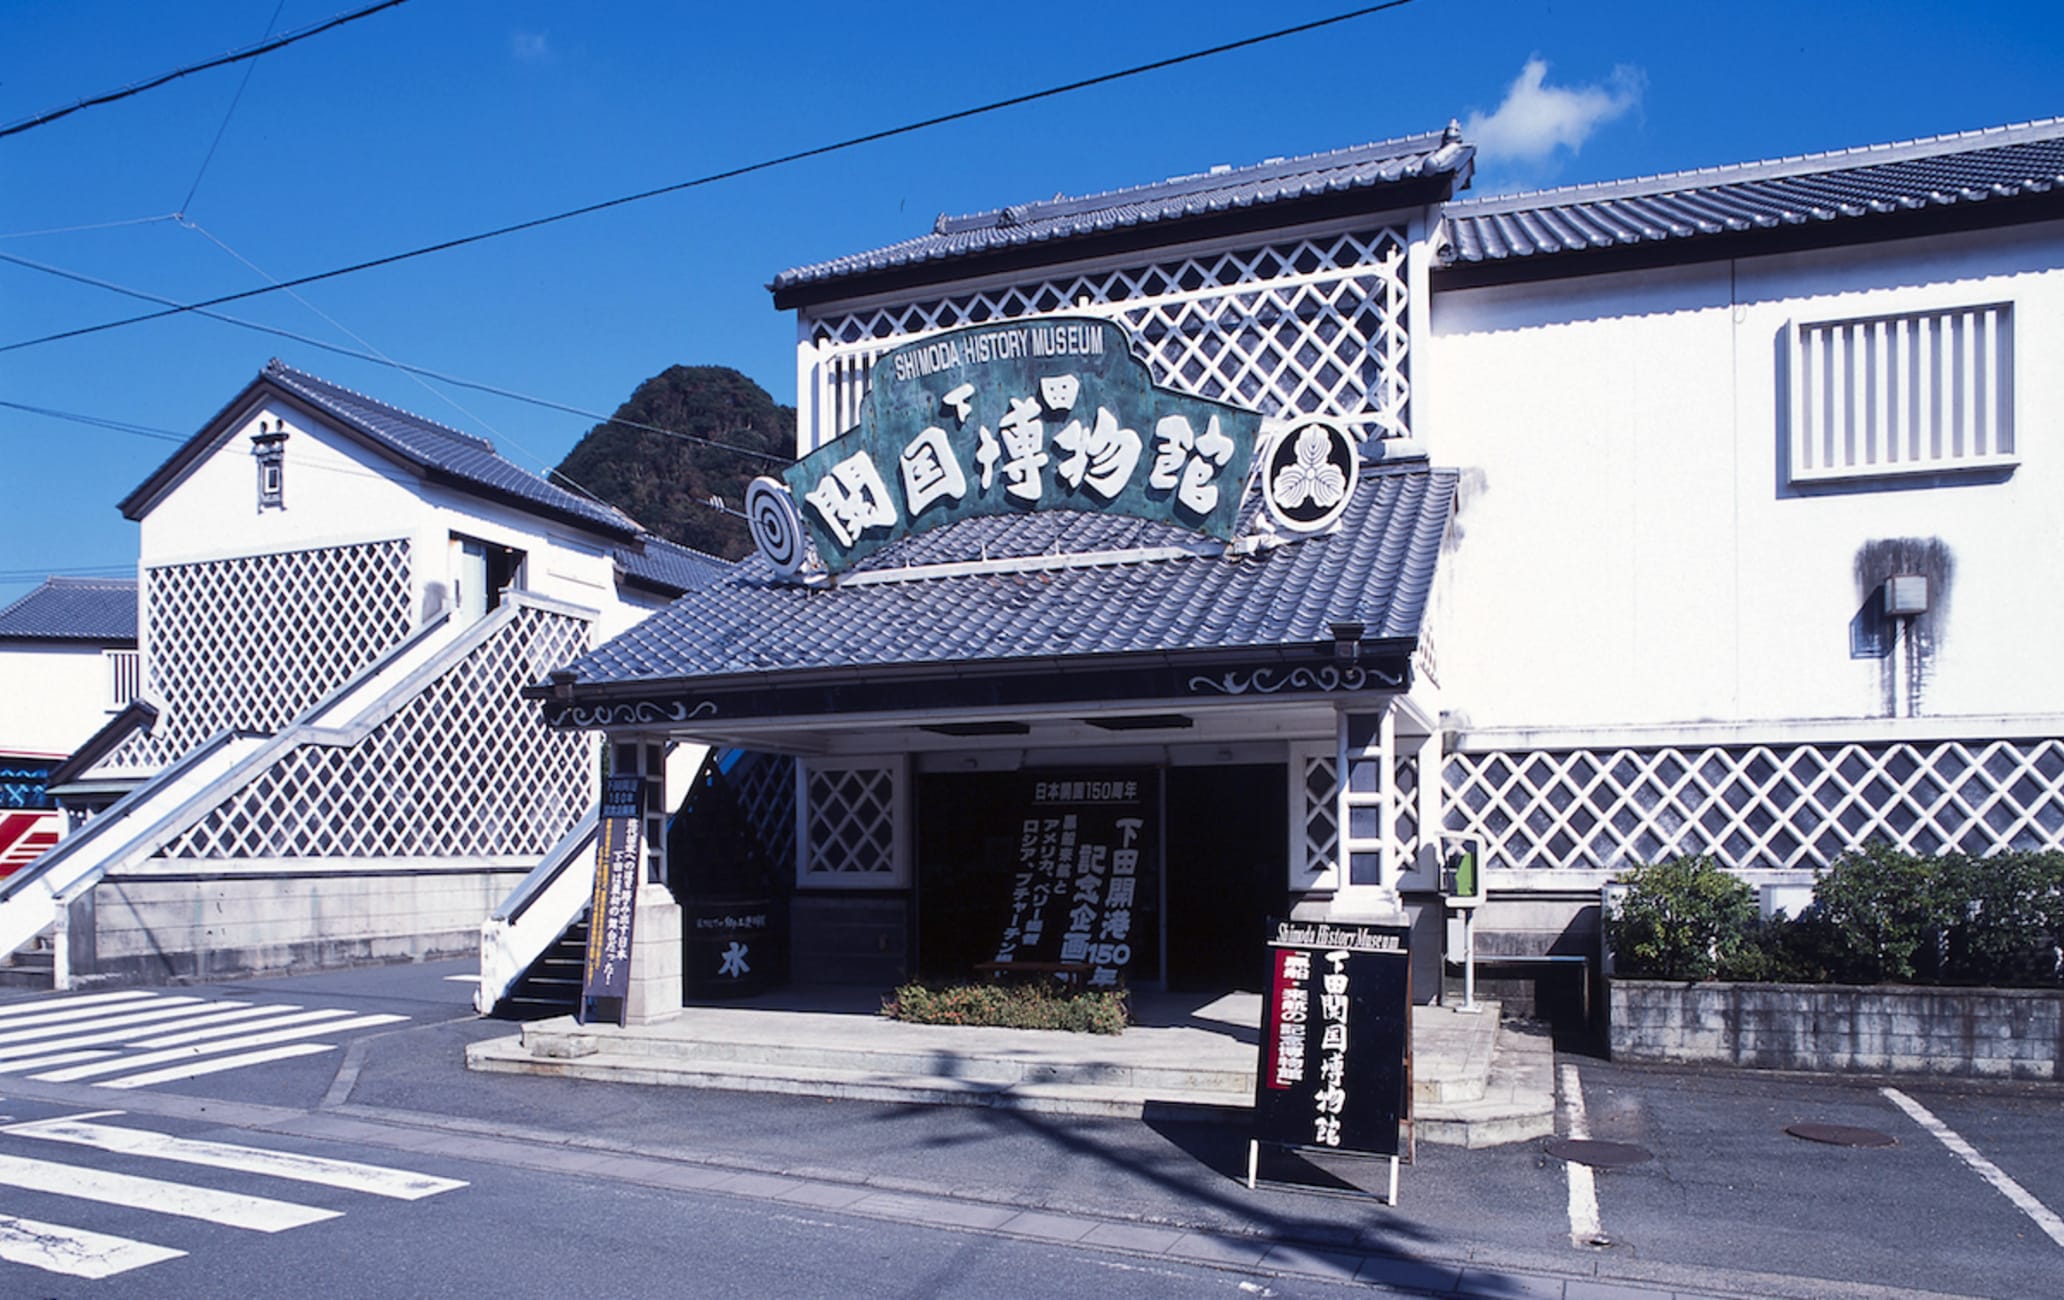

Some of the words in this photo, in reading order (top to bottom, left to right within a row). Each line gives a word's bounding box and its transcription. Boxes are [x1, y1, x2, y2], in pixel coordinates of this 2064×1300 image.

[894, 347, 962, 382] SHIMODA
[963, 329, 1029, 364] HISTORY
[1032, 325, 1105, 358] MUSEUM
[1086, 816, 1144, 987] 下田開港150年
[1276, 921, 1316, 945] Shimoda
[1316, 924, 1357, 949] History
[1355, 927, 1401, 950] Museum
[717, 941, 751, 979] 水
